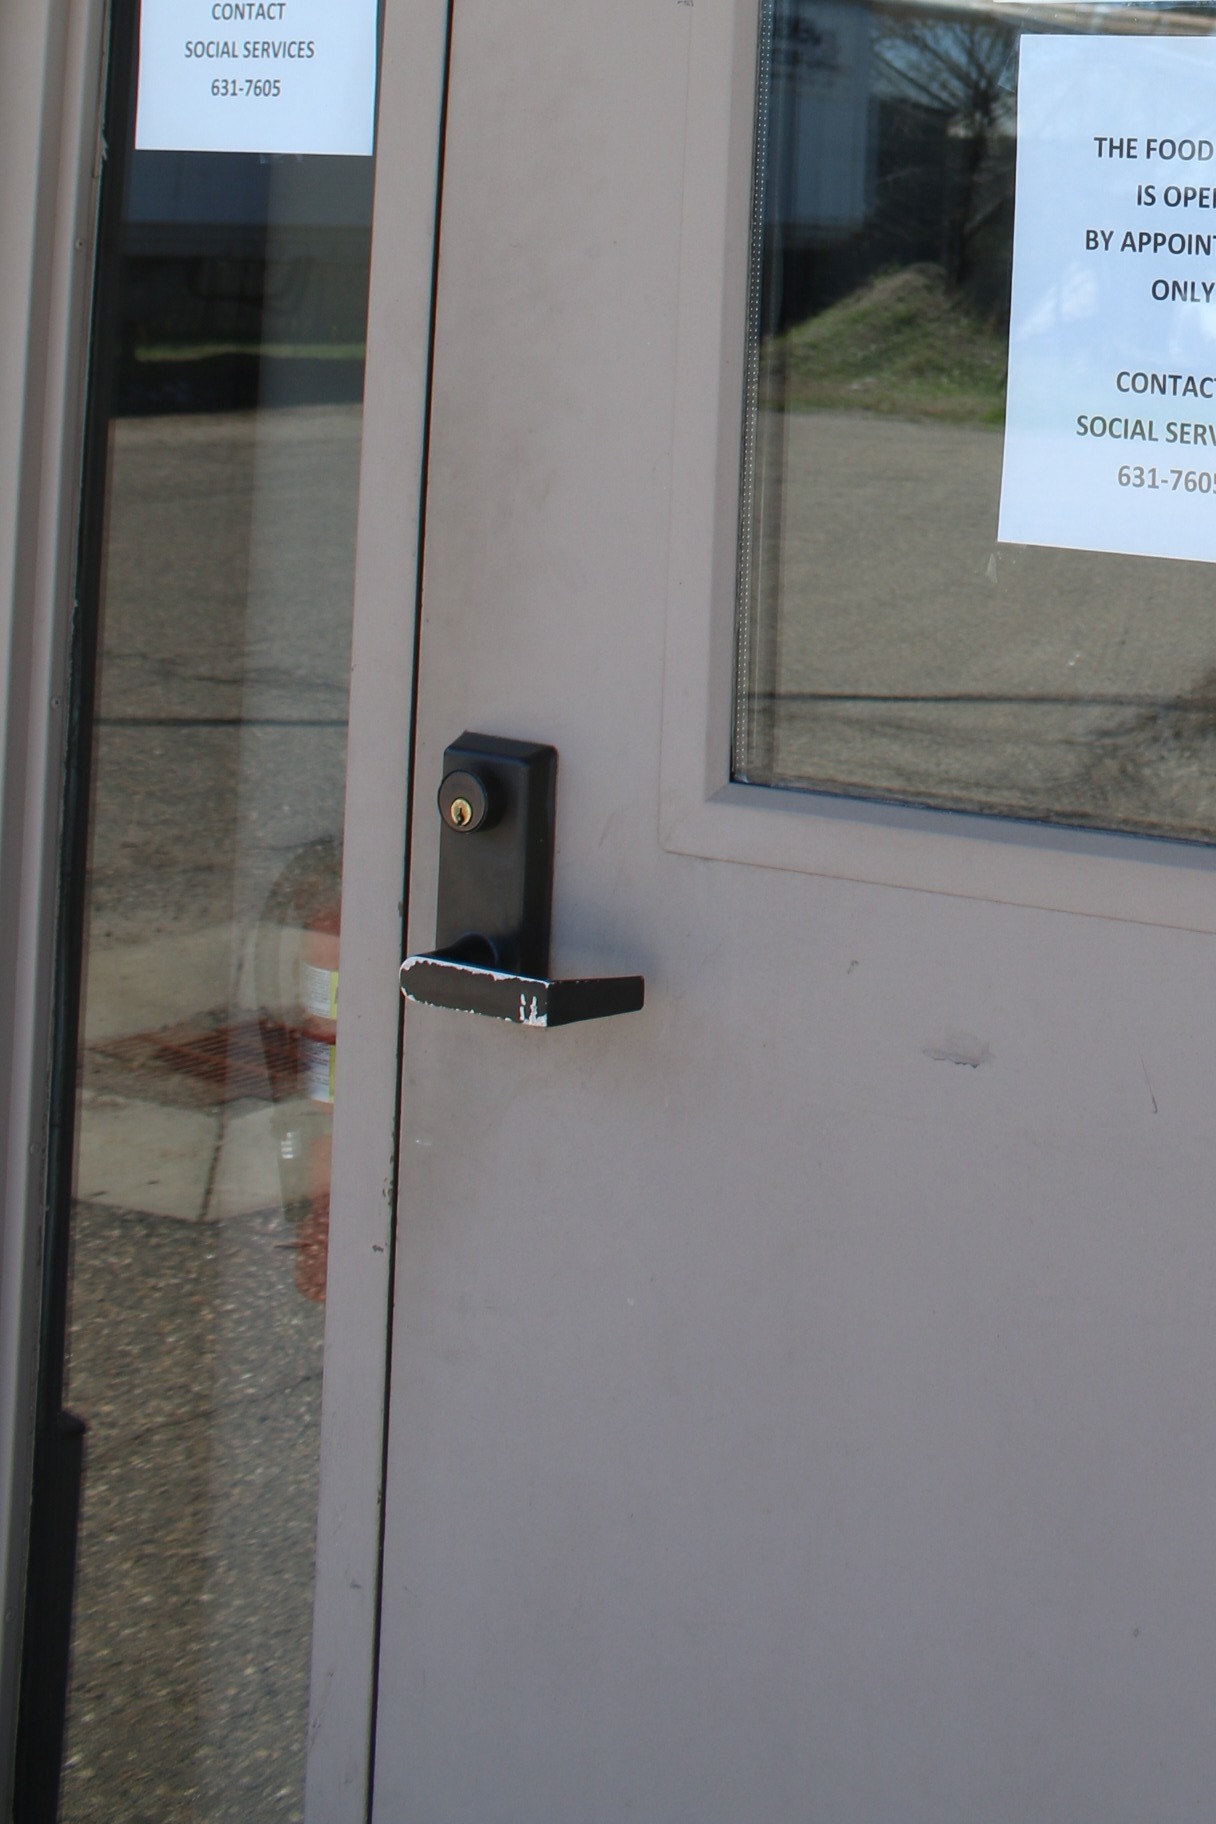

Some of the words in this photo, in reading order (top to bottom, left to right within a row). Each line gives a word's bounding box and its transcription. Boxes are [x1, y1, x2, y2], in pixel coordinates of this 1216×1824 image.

[211, 2, 286, 21] CONTACT
[184, 41, 239, 59] SOCIAL
[242, 41, 315, 59] SERVICES
[210, 79, 281, 98] 631-7605
[1094, 137, 1139, 161] THE
[1146, 138, 1214, 162] FOOD
[1136, 185, 1157, 207] IS
[1085, 229, 1115, 252] BY
[1151, 279, 1216, 303] ONLY
[1076, 415, 1159, 442] SOCIAL
